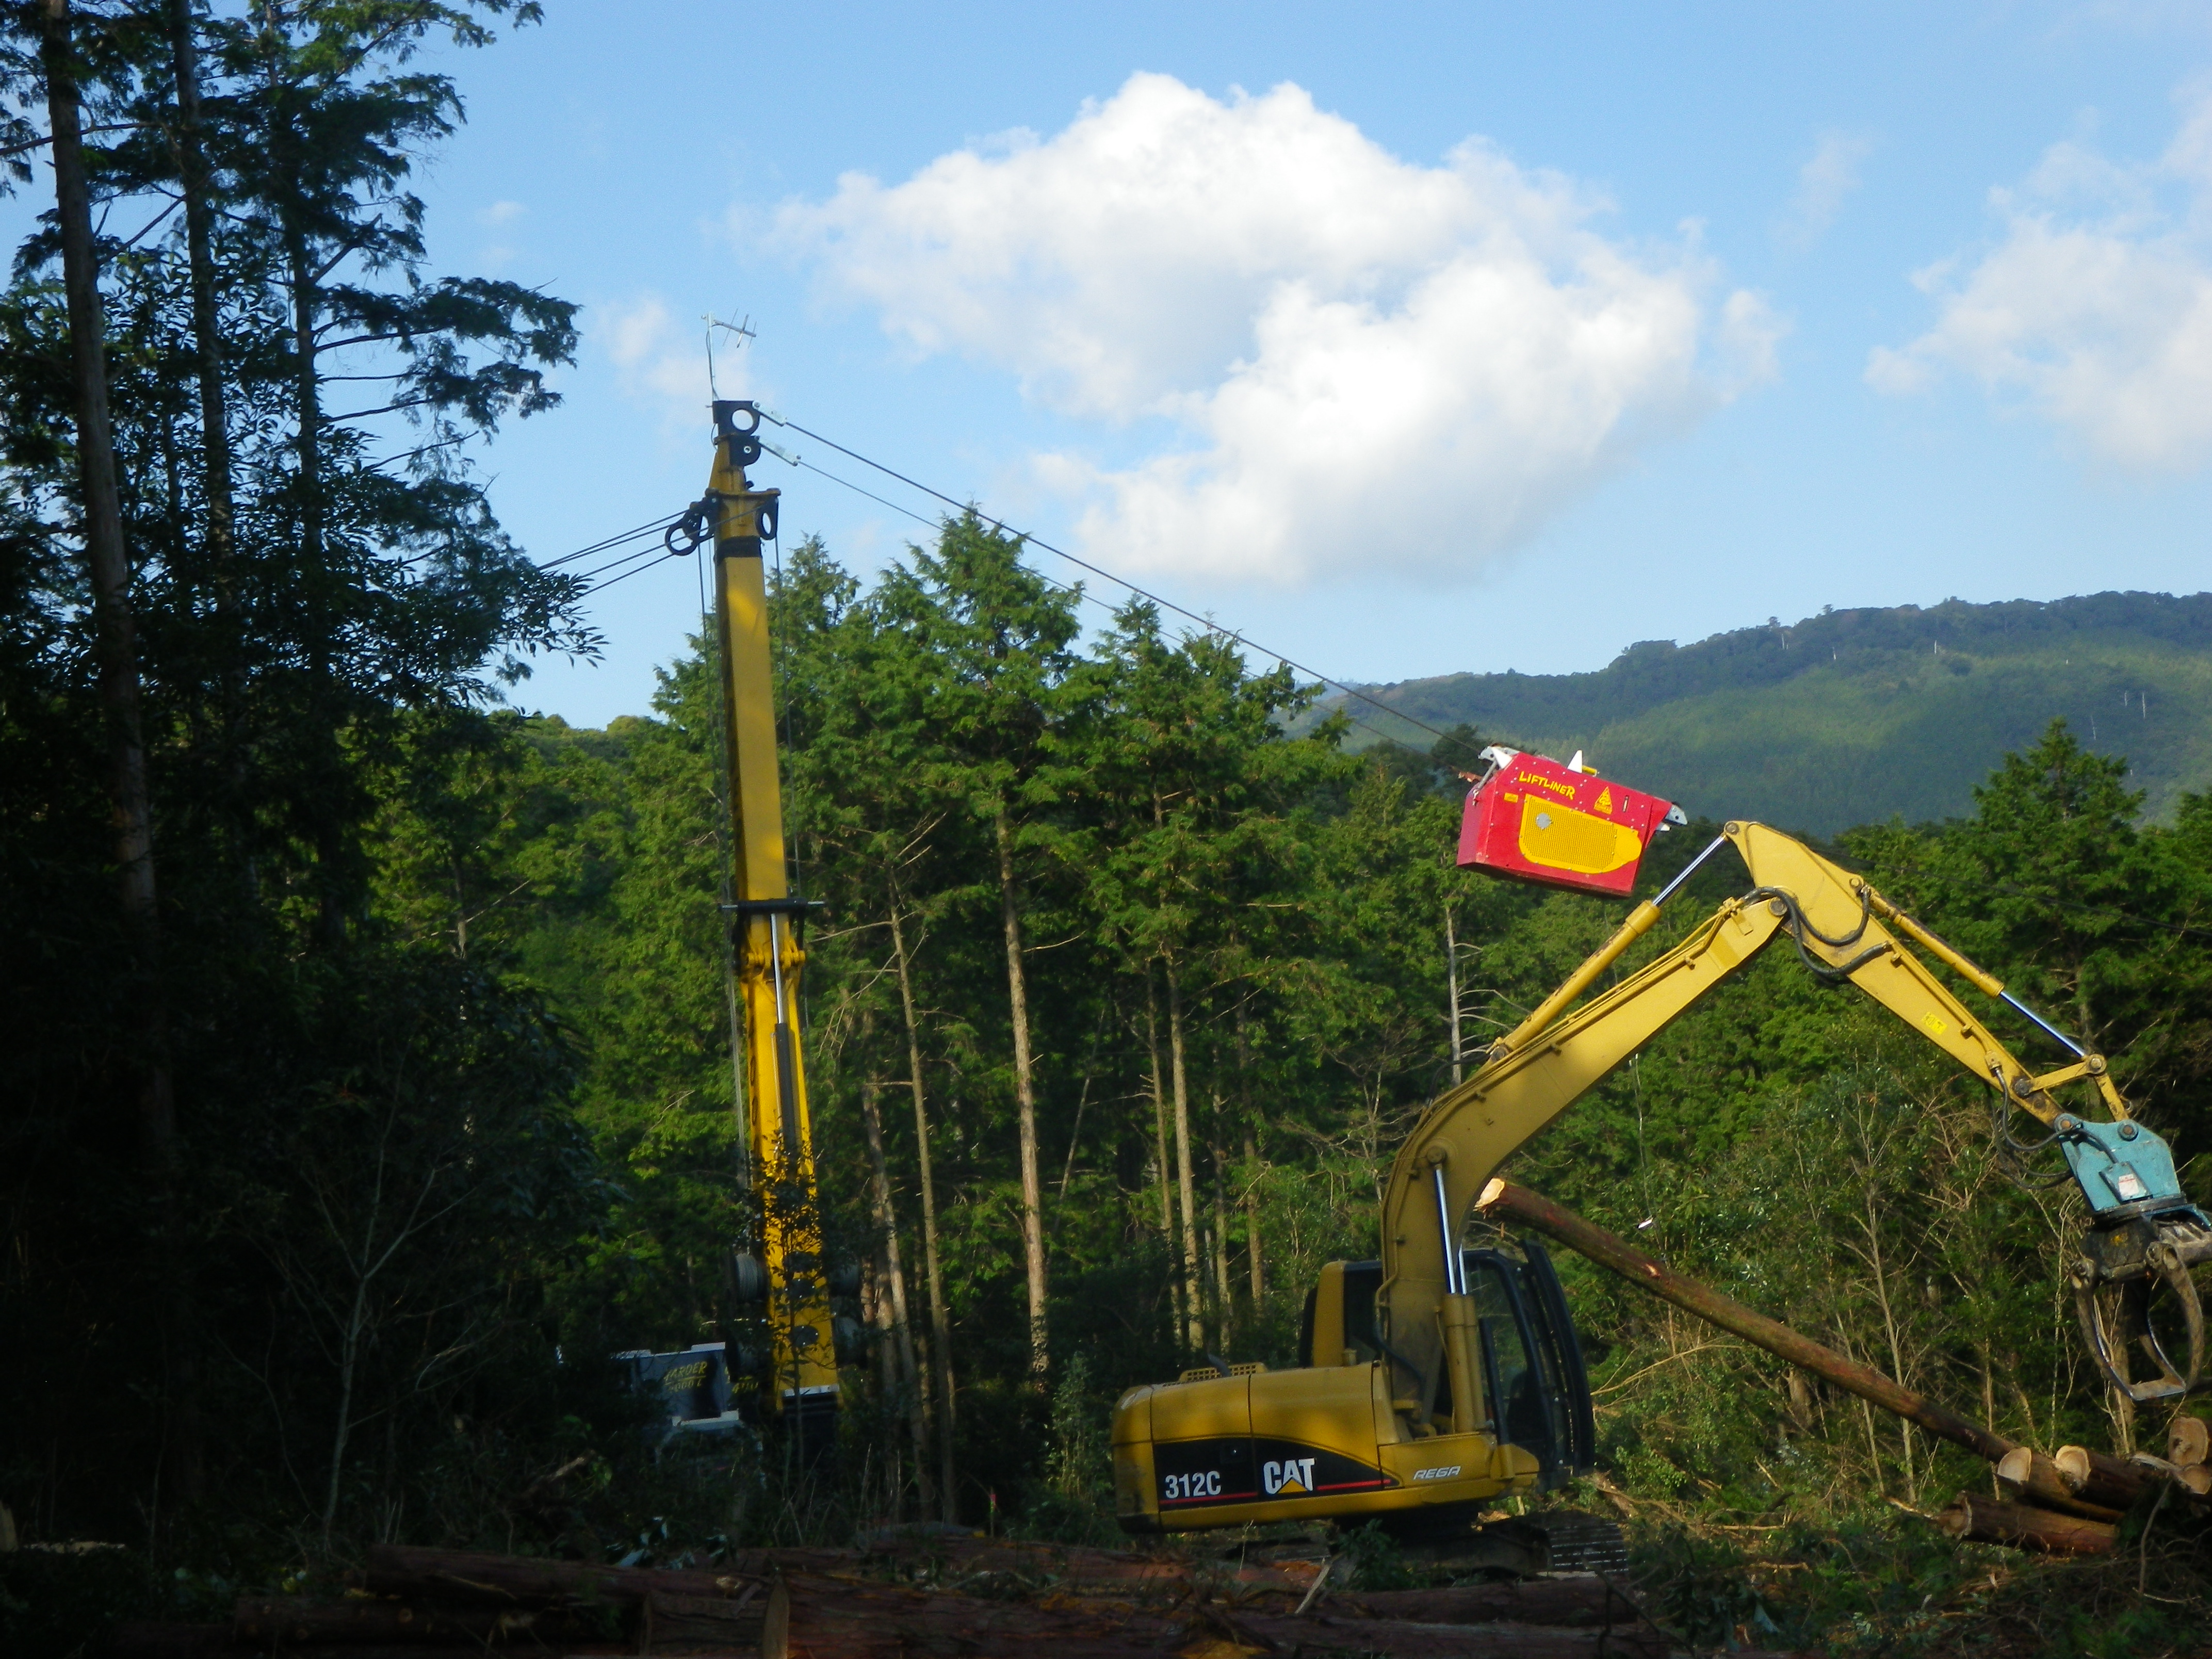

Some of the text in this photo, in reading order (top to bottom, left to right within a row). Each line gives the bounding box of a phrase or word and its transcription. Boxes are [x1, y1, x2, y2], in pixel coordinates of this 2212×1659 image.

[1519, 771, 1575, 800] LIFTLINER
[1164, 1470, 1222, 1499] 312C
[1263, 1458, 1315, 1494] CAT
